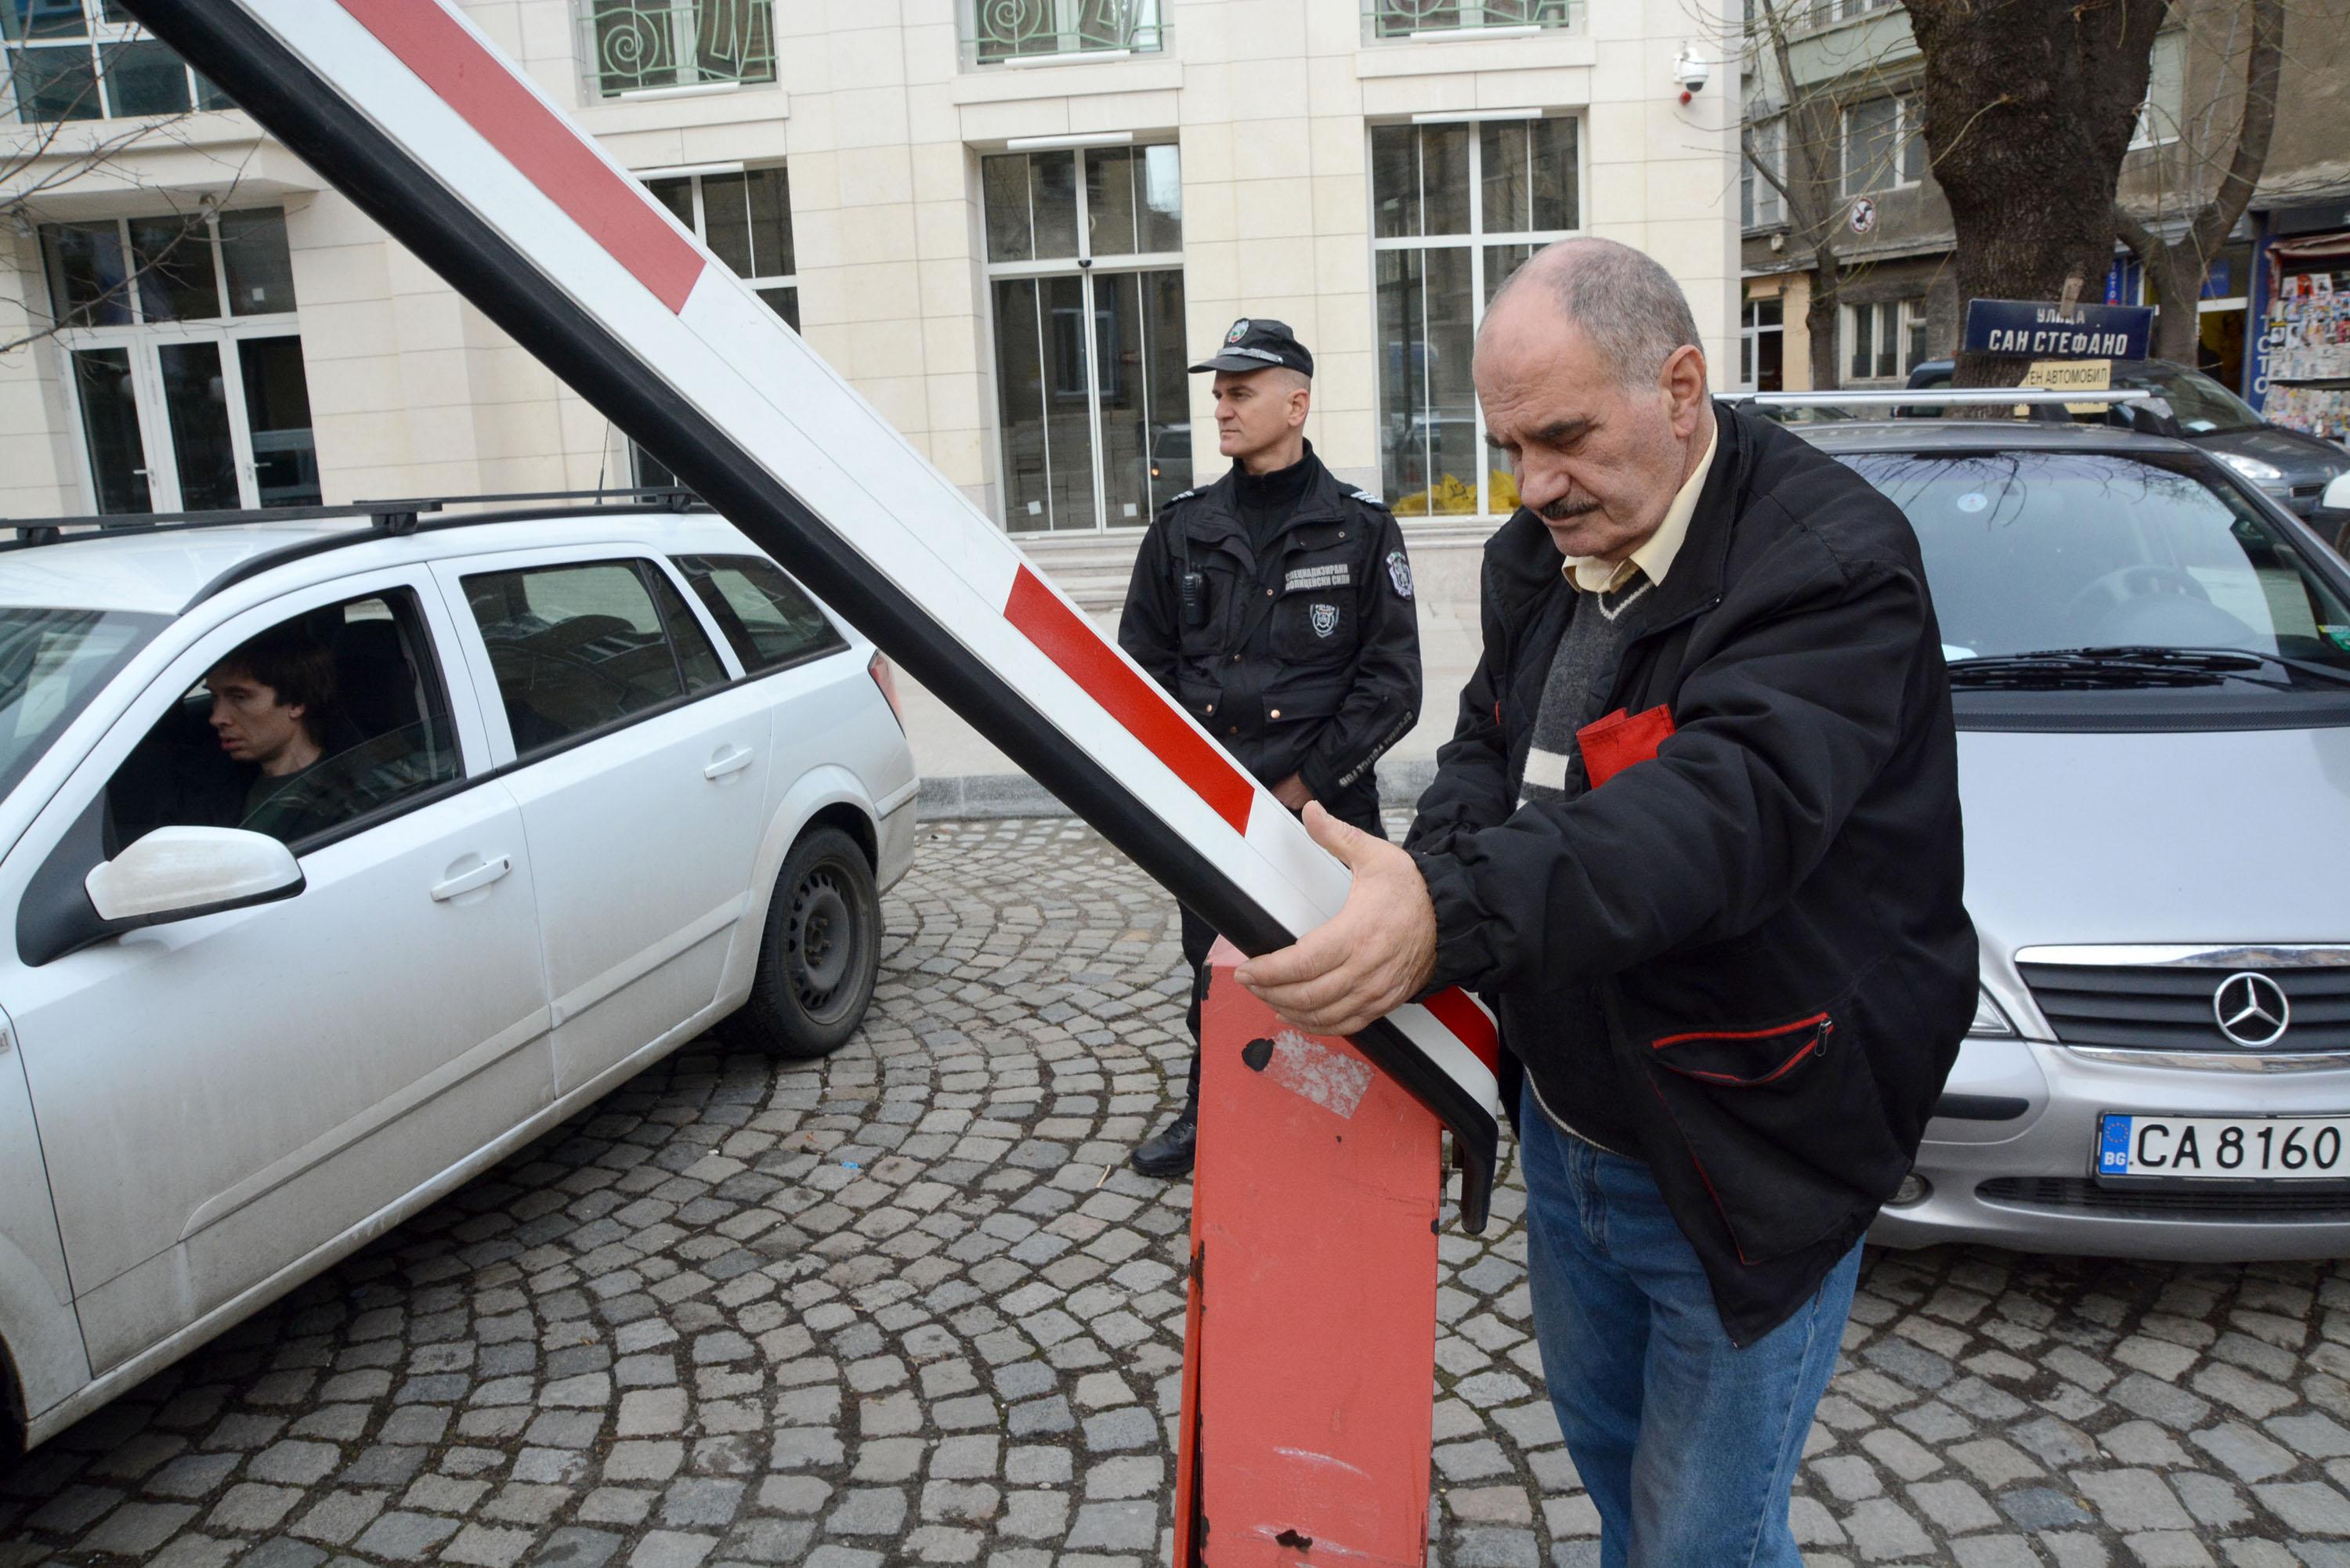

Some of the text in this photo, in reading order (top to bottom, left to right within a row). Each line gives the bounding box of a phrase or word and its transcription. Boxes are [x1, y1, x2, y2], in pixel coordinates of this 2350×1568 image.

[1989, 329, 2128, 356] САН СТЕФАНО
[2045, 367, 2107, 384] АВТОМОБИЛ
[2104, 1151, 2127, 1165] BG
[2216, 1126, 2341, 1169] 8160
